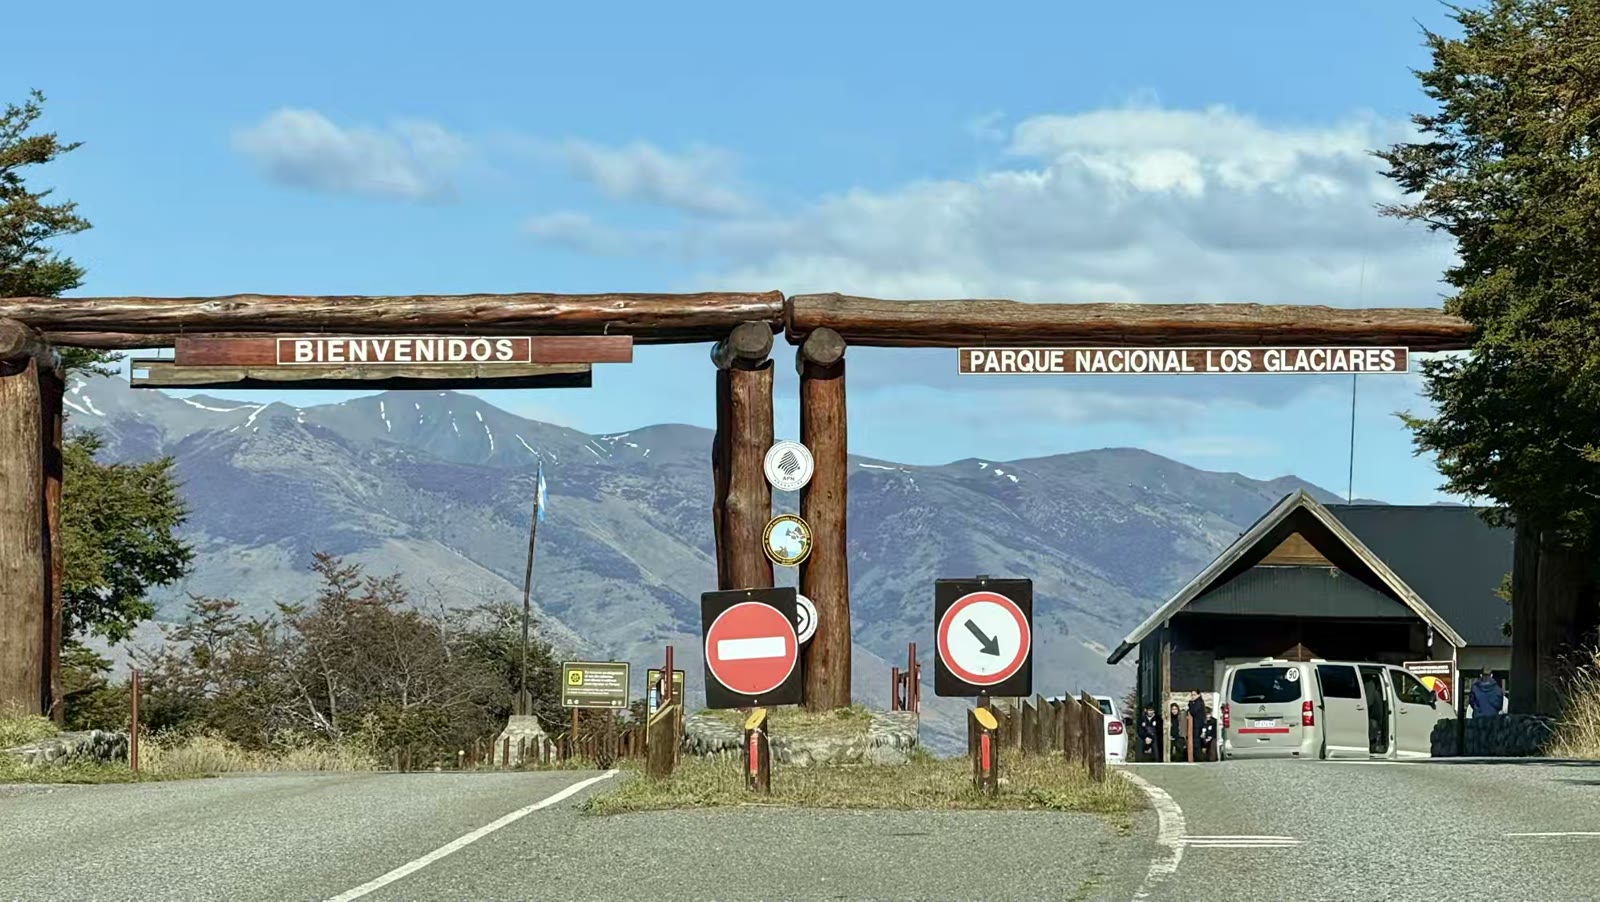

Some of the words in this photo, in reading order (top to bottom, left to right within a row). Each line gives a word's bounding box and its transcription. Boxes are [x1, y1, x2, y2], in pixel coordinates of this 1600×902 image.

[294, 338, 514, 361] BIENVENIDOS
[970, 350, 1064, 373] PARQUE
[1075, 350, 1195, 372] NACIONAL
[1206, 350, 1252, 372] LOS
[1263, 349, 1396, 372] GLACIARES
[1288, 670, 1297, 679] 90
